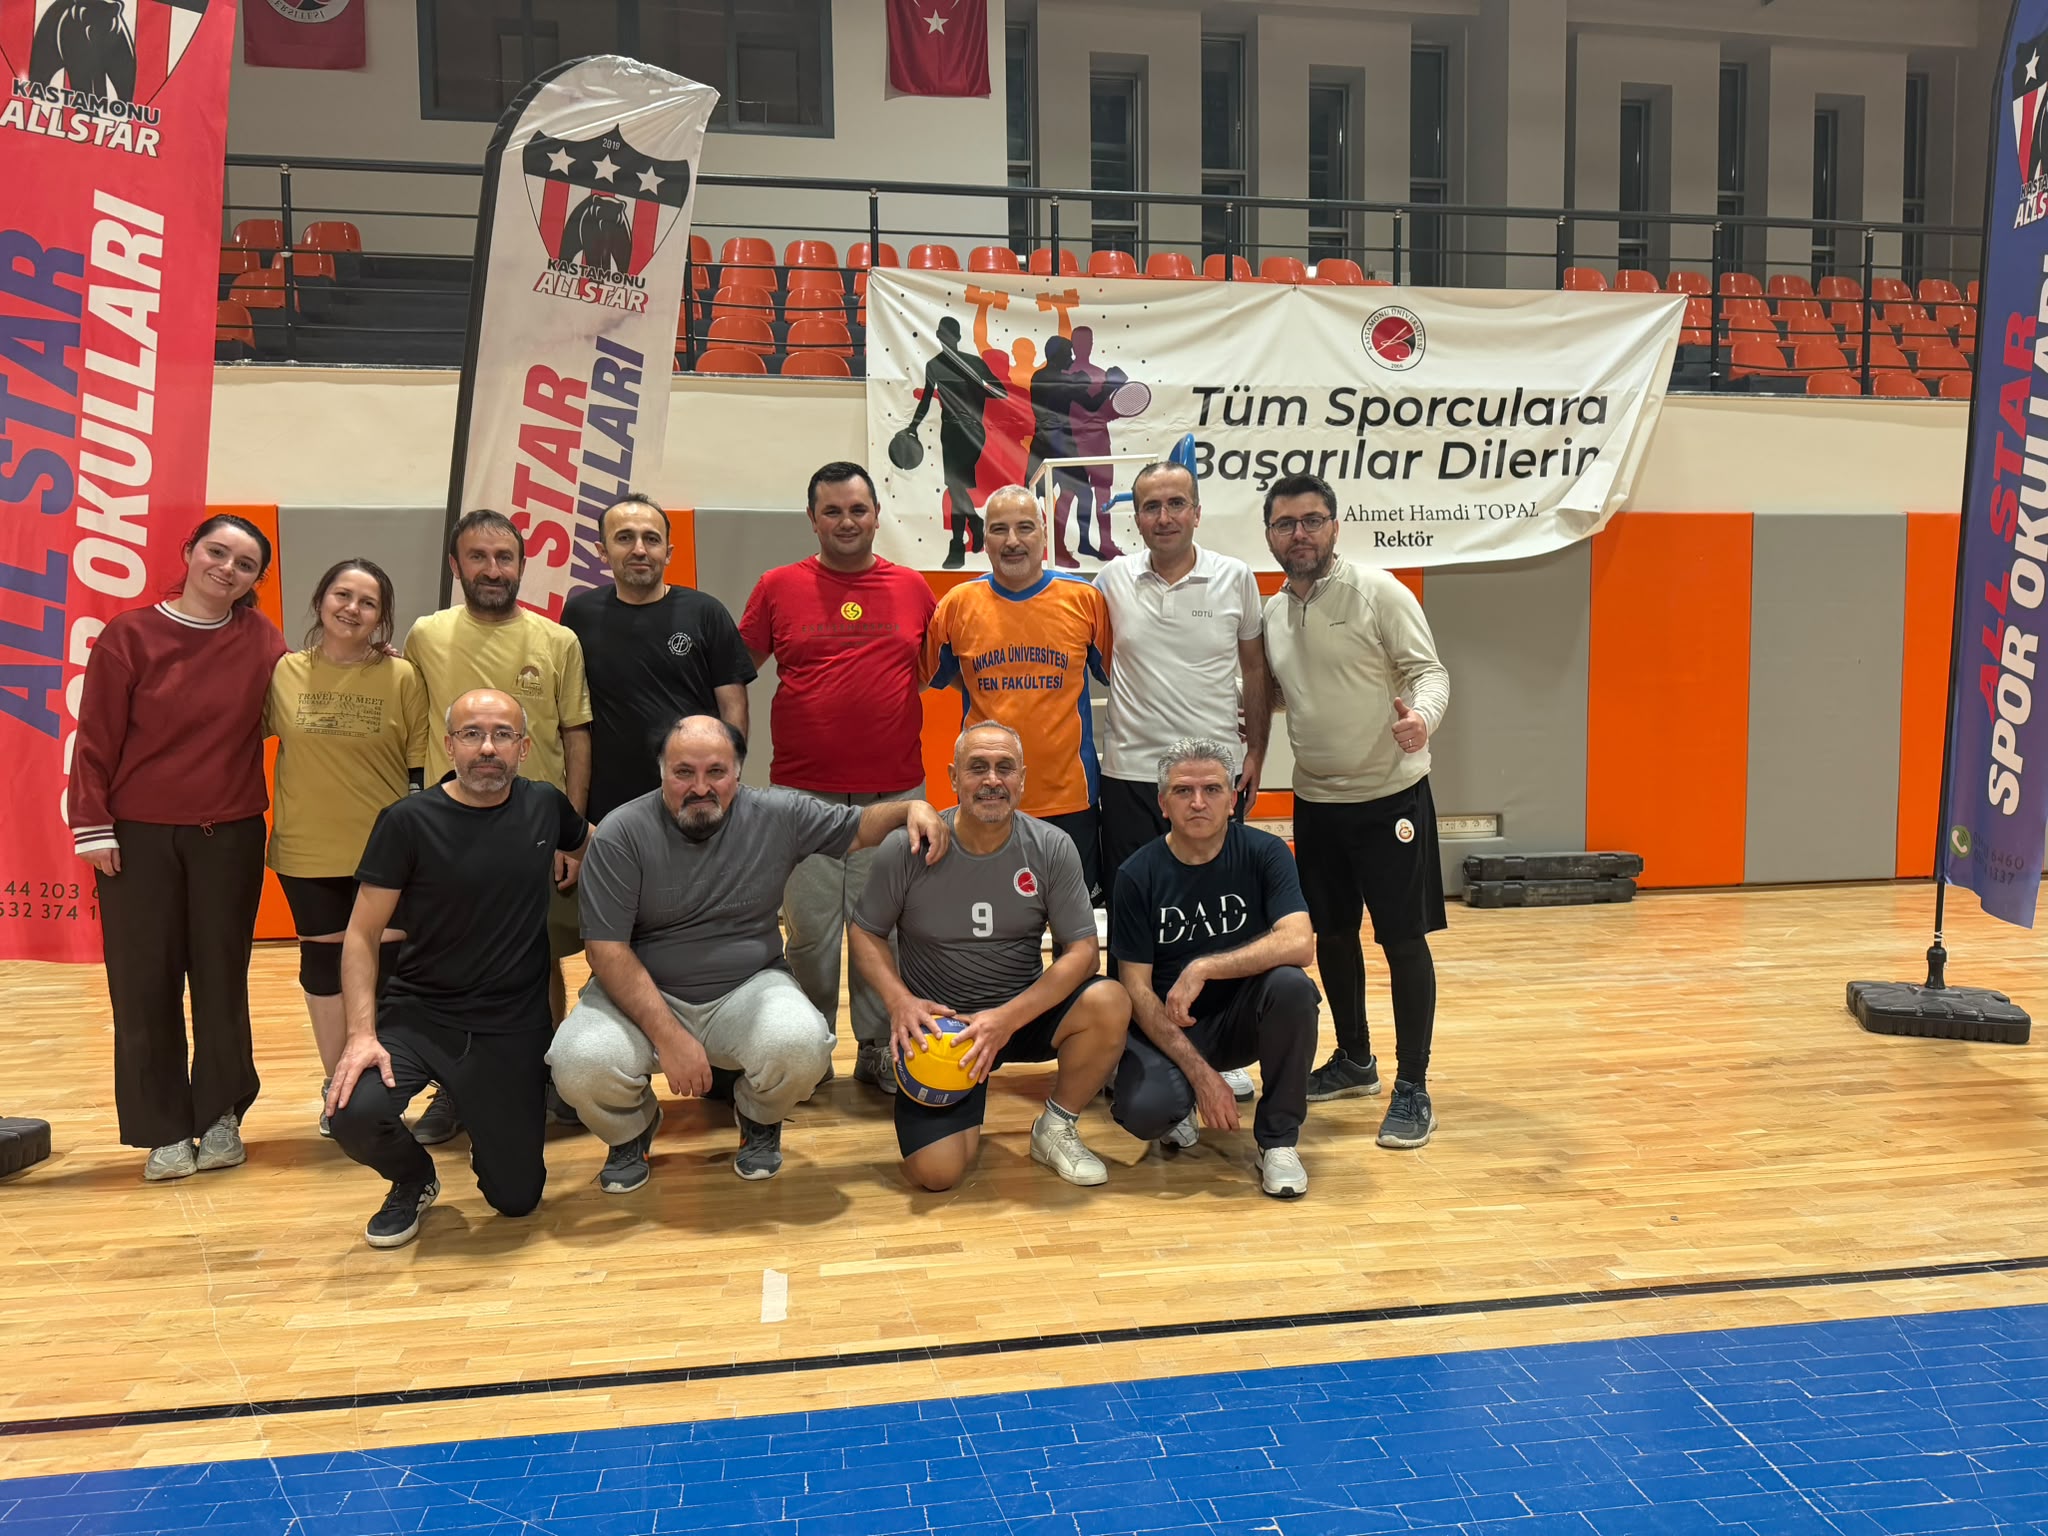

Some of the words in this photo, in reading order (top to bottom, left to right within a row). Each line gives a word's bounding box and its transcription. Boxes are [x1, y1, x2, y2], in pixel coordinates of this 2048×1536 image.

[12, 78, 161, 125] KASTAMONU
[0, 99, 161, 157] ALLSTAR
[533, 271, 648, 314] ALLSTAR
[547, 258, 646, 288] KASTAMONU
[0, 228, 85, 514] STAR
[74, 189, 165, 598] OKULLARI
[1192, 385, 1307, 426] Tüm
[1325, 387, 1608, 436] Sporculara
[1988, 310, 2037, 543] STAR
[510, 364, 588, 568] STAR
[1194, 439, 1423, 491] Başarılar
[1344, 505, 1404, 522] Ahmet
[1410, 504, 1470, 521] Hamdi
[1474, 502, 1539, 520] TOPAL
[1374, 530, 1434, 547] Rektör
[1192, 609, 1213, 618] ODTÜ
[0, 550, 68, 738] ALL
[973, 648, 1006, 674] ANKARA
[1008, 643, 1069, 670] ÜNİVERSİTESİ
[1978, 571, 2009, 724] ALL
[298, 692, 334, 701] TRAVEL
[338, 694, 352, 702] TO
[355, 697, 384, 706] MEET
[978, 678, 998, 690] FEN
[1002, 673, 1063, 690] FAKÜLTESİ
[1988, 624, 2038, 816] SPOR
[40, 882, 79, 899] 203
[41, 903, 78, 920] 374
[971, 902, 993, 937] 9
[1158, 893, 1247, 944] DAD
